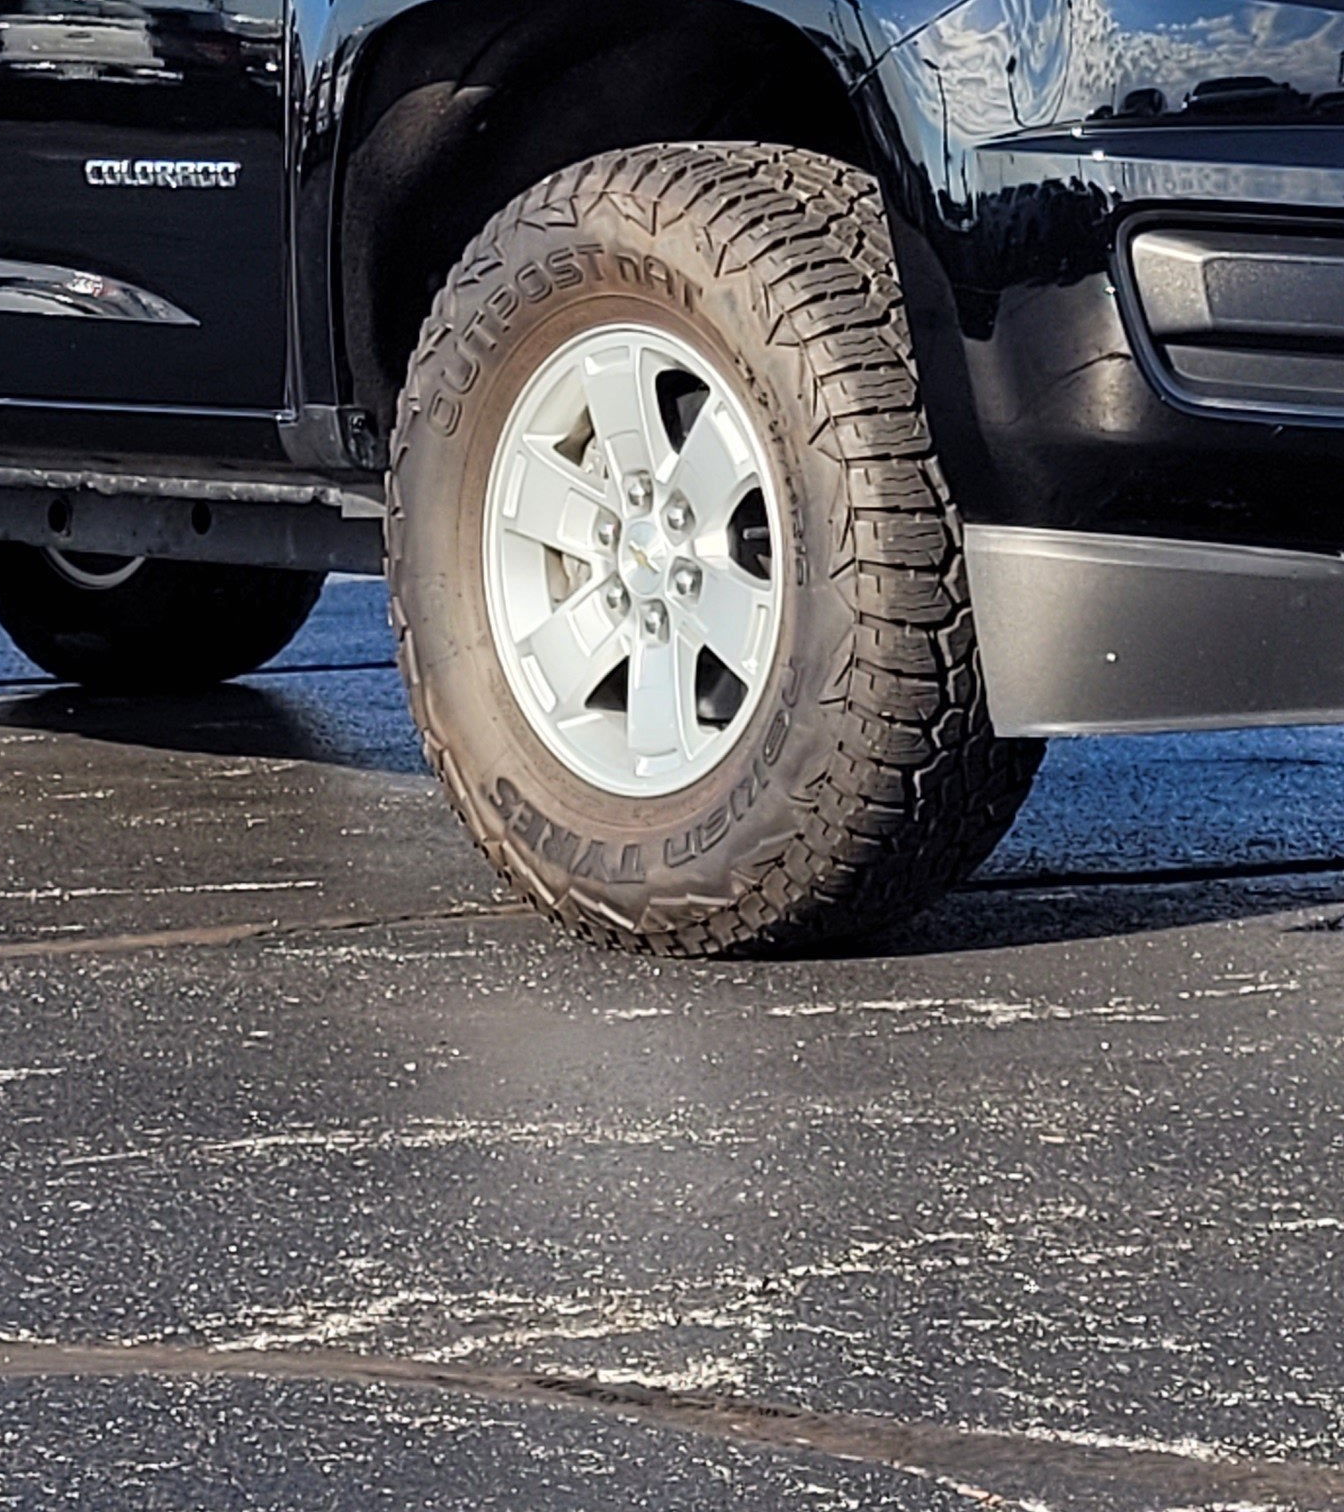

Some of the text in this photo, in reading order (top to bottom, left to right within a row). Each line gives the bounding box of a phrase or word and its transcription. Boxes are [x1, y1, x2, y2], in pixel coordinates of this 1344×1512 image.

[85, 159, 241, 188] COLORADO
[427, 243, 605, 437] OUTPOST
[489, 777, 647, 884] TYRES
